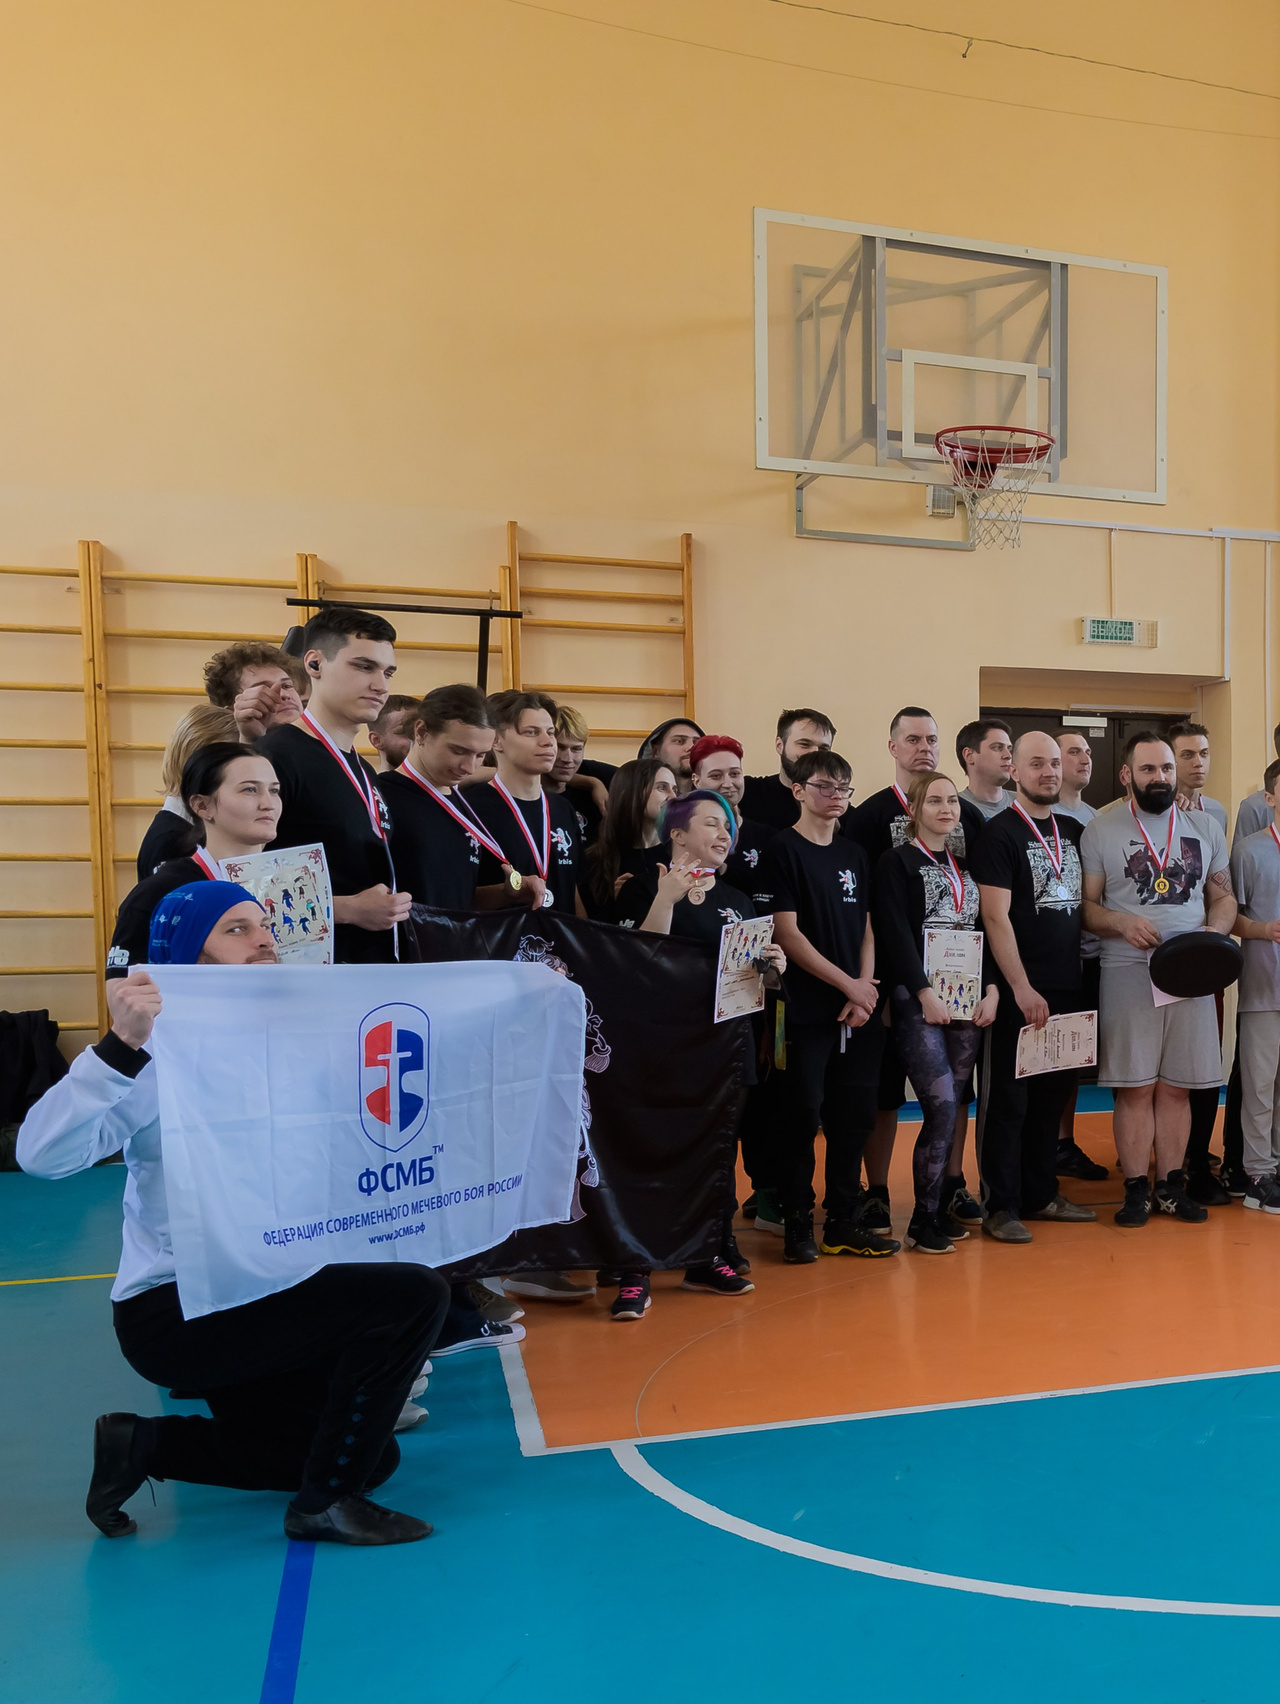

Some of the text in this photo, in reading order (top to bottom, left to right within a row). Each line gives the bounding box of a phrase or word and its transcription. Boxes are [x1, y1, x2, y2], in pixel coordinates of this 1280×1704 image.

[1091, 623, 1134, 638] ВЫХОД
[357, 1155, 436, 1197] ФСМБ
[263, 1174, 523, 1247] ФЕДЕРАЦИЯ СОВРЕМЕННОГО МЕЧЕВОГО БОЯ РОССИИ
